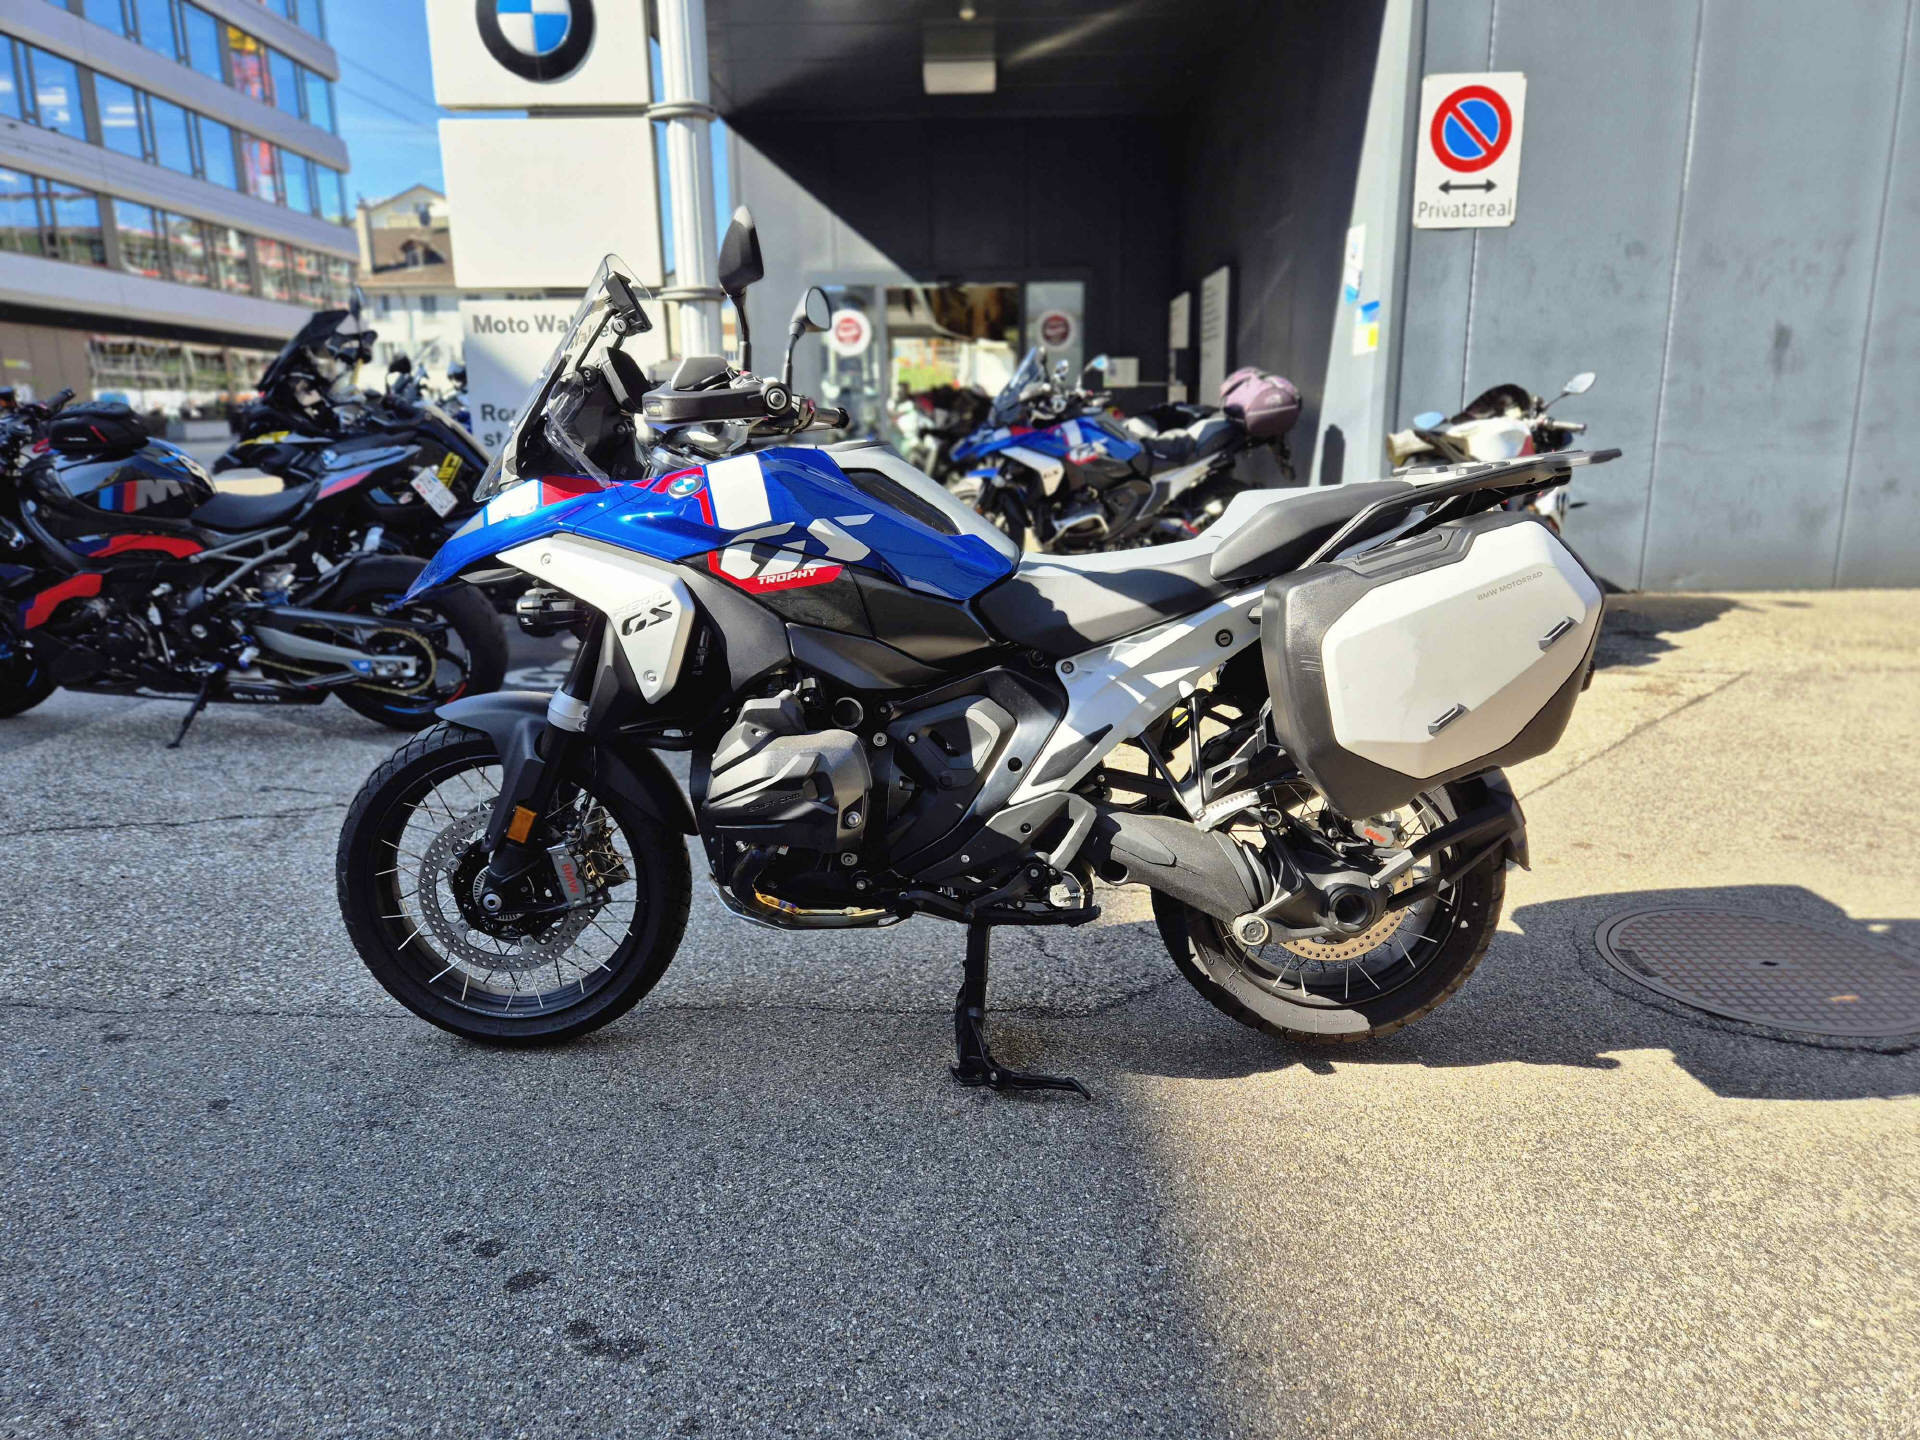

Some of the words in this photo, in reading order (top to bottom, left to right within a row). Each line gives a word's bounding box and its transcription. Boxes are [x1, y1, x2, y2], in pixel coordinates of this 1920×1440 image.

[1417, 198, 1513, 218] Privatareal
[472, 314, 530, 334] Moto
[757, 568, 818, 585] TROPHY
[1477, 588, 1498, 601] BMW
[1499, 571, 1544, 592] MOTORRAD
[621, 600, 673, 636] GS
[562, 863, 580, 894] BMW
